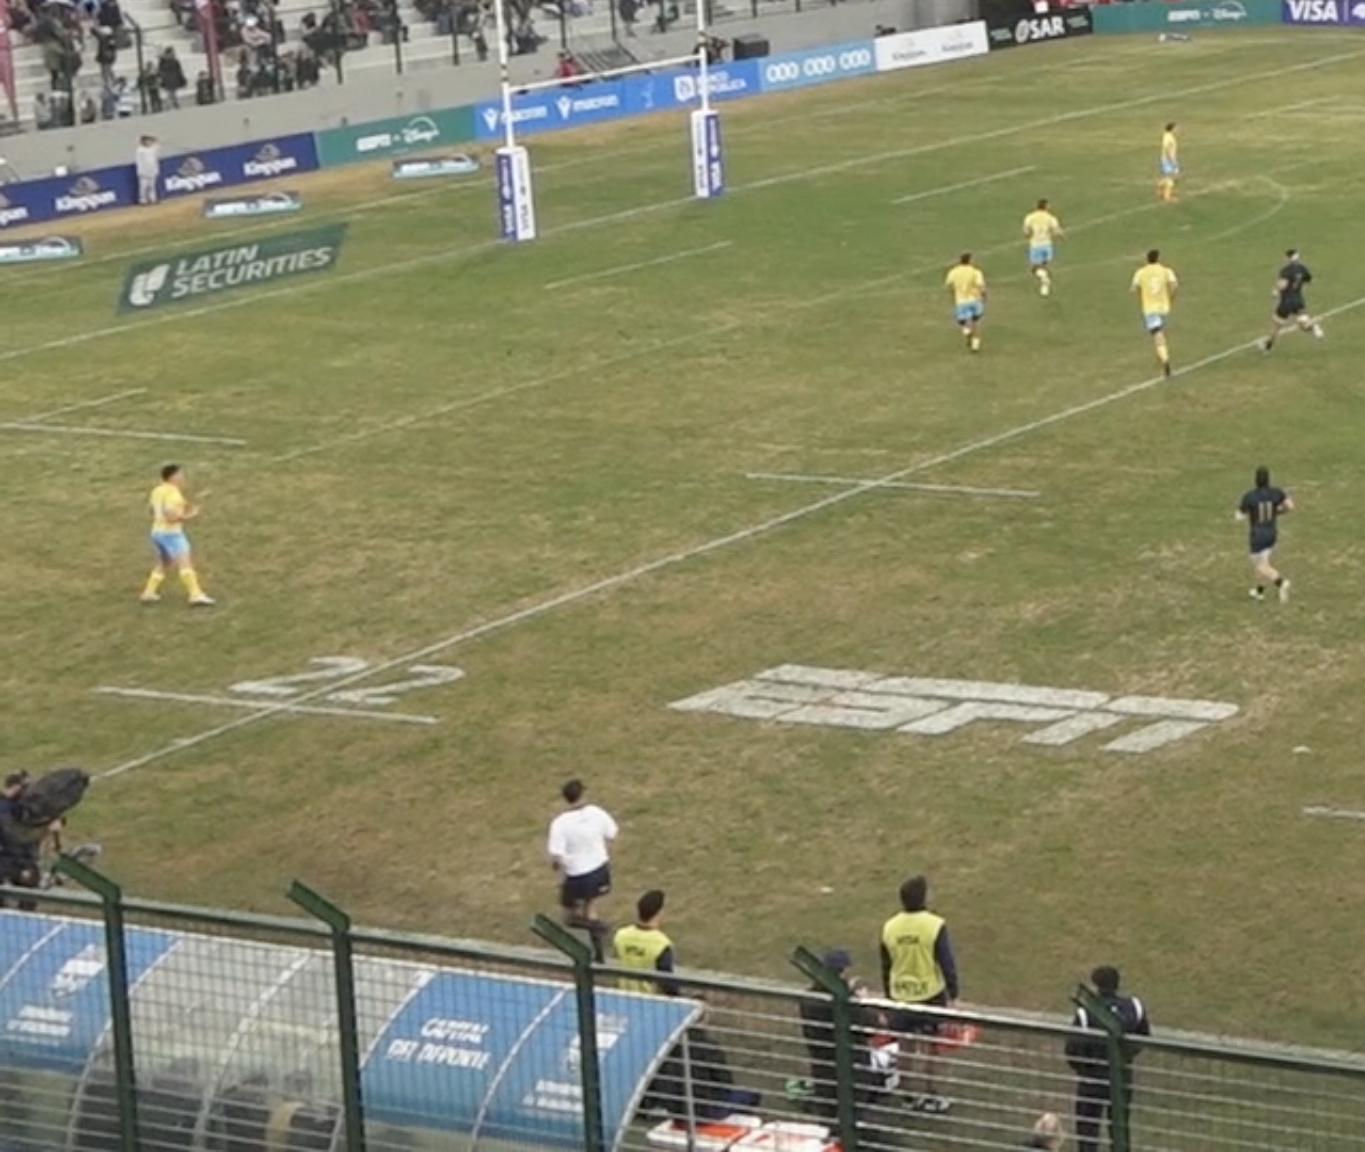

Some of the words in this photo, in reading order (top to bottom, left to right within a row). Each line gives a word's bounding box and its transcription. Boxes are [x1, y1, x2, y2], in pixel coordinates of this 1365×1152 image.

[1286, 0, 1337, 22] VISA
[503, 105, 547, 122] acron
[573, 94, 619, 113] macron
[171, 246, 333, 298] SECURITIES
[175, 244, 259, 278] LATIN
[1258, 501, 1272, 522] 11
[228, 655, 467, 705] 22
[666, 663, 1240, 753] ESPN
